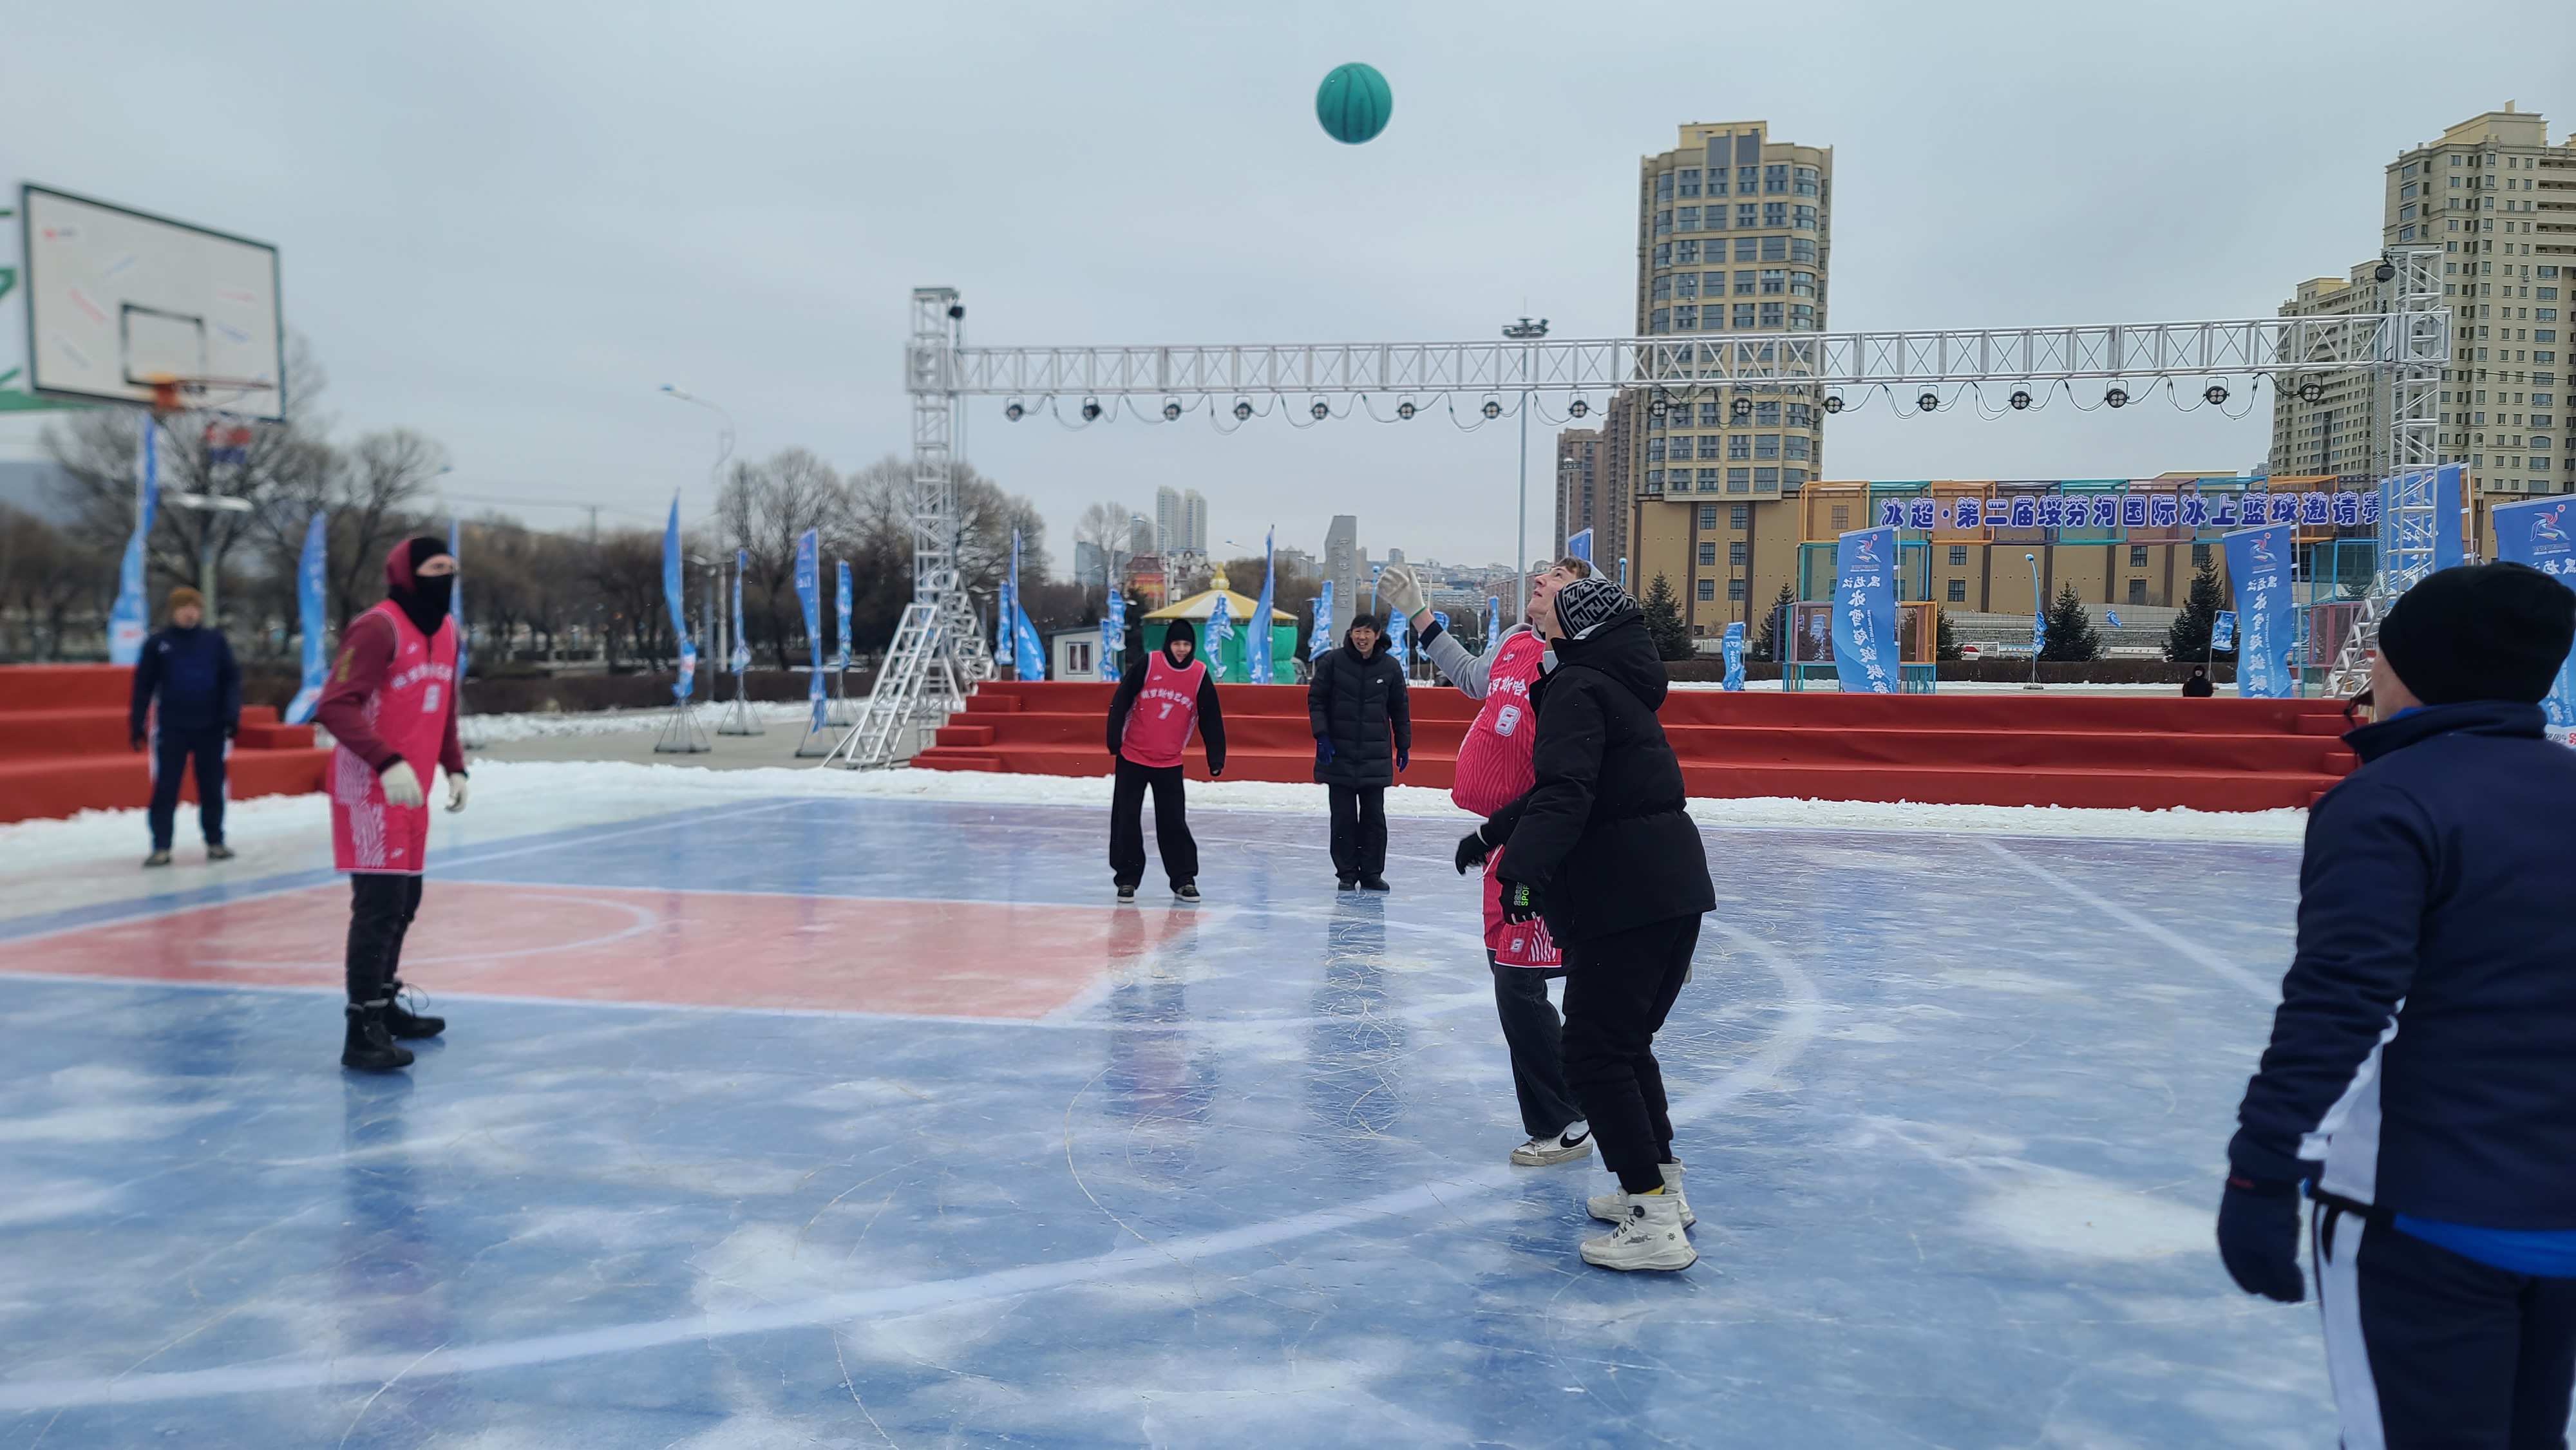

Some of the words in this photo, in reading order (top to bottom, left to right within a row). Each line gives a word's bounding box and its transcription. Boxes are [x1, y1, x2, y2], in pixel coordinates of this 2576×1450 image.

[1486, 675, 1530, 701] 罗斯哈
[1158, 702, 1174, 720] 7
[1495, 704, 1521, 737] 8
